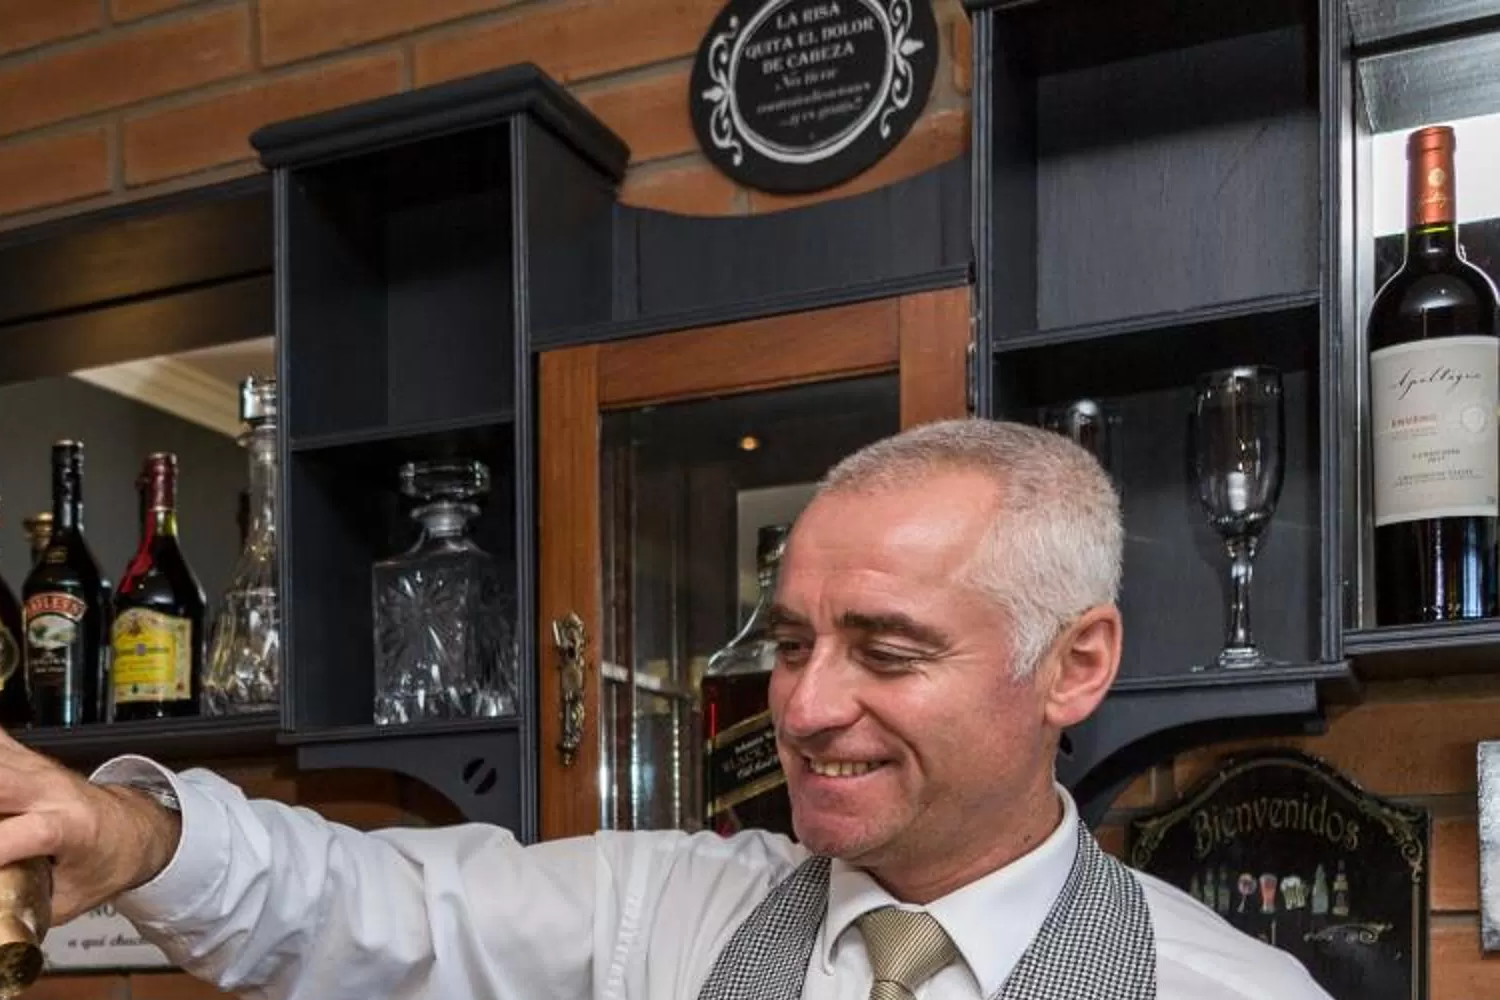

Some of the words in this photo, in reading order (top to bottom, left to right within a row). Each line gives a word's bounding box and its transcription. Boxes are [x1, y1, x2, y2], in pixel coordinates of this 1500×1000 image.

[776, 11, 798, 30] LA
[802, 2, 840, 23] RISA
[745, 35, 793, 59] QUITA
[797, 31, 818, 46] EL
[821, 16, 874, 41] DOLOR
[762, 58, 784, 75] DE
[785, 40, 855, 69] CABEZA
[1193, 792, 1360, 860] Bienvenidos
